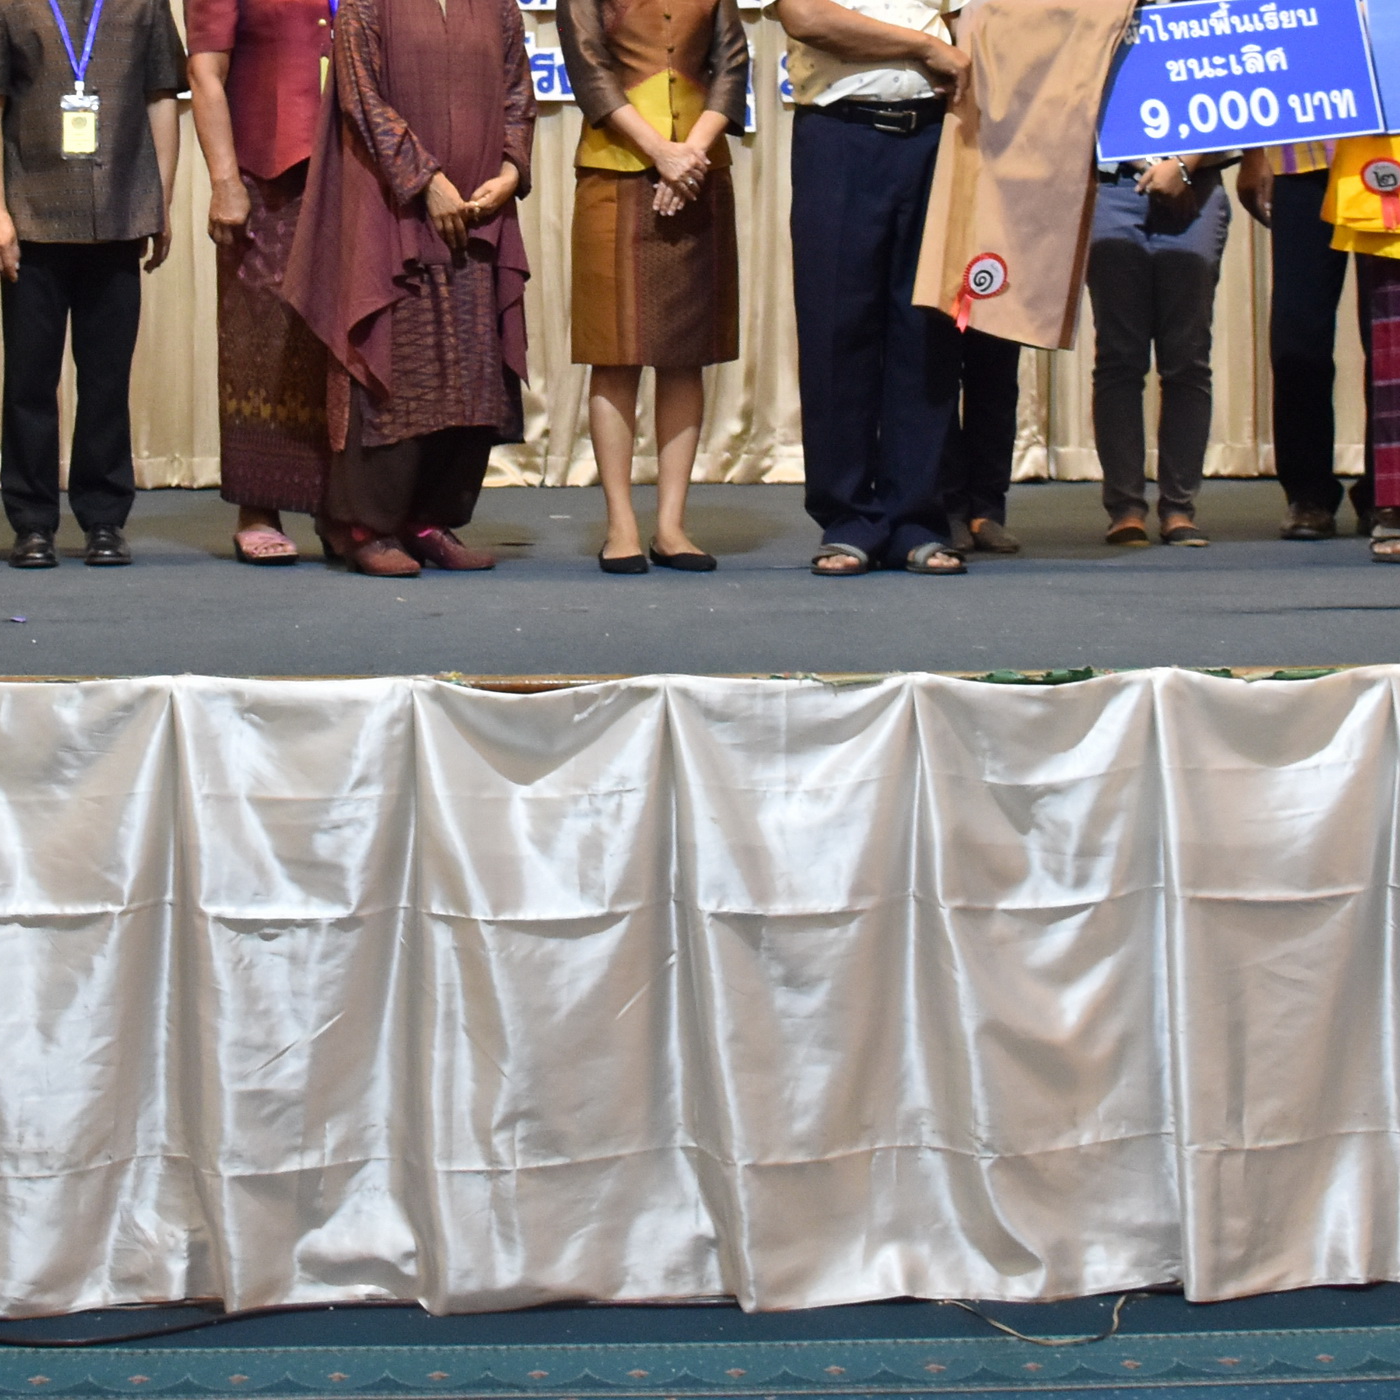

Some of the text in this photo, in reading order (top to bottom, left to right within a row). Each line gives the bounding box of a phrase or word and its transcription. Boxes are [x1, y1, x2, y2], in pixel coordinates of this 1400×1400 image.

[1165, 43, 1289, 82] ชนะเลิศ
[1139, 86, 1358, 140] 9,000 บาท
